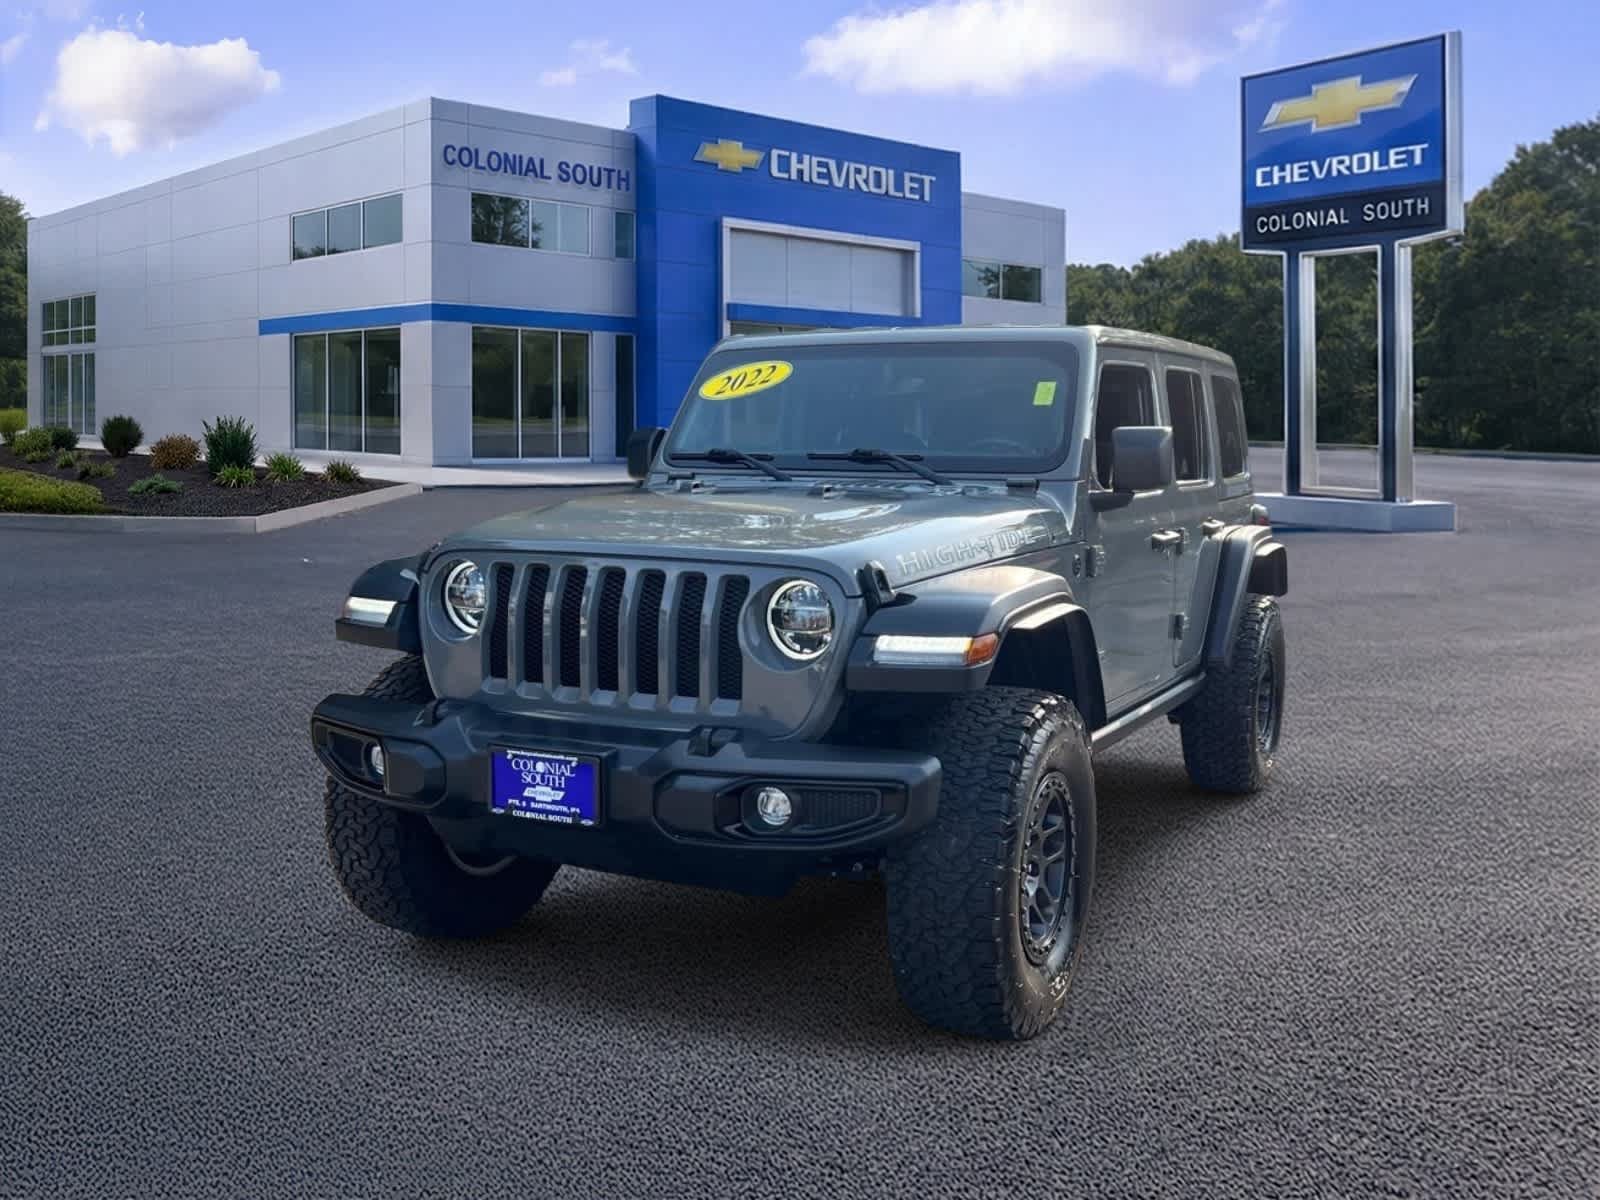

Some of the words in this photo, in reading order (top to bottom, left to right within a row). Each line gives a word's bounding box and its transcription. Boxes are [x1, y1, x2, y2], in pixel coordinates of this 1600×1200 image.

[442, 144, 552, 181] COLONIAL
[557, 160, 631, 192] SOUTH
[769, 148, 936, 202] CHEVROLET
[1255, 143, 1429, 187] CHEVROLET
[1256, 207, 1350, 234] COLONIAL
[1362, 197, 1430, 222] SOUTH
[713, 364, 778, 396] 2022
[511, 758, 576, 777] COLONIAL
[521, 771, 565, 788] SOUTH
[512, 809, 547, 820] COLONIAL
[548, 814, 573, 824] SOUTH
